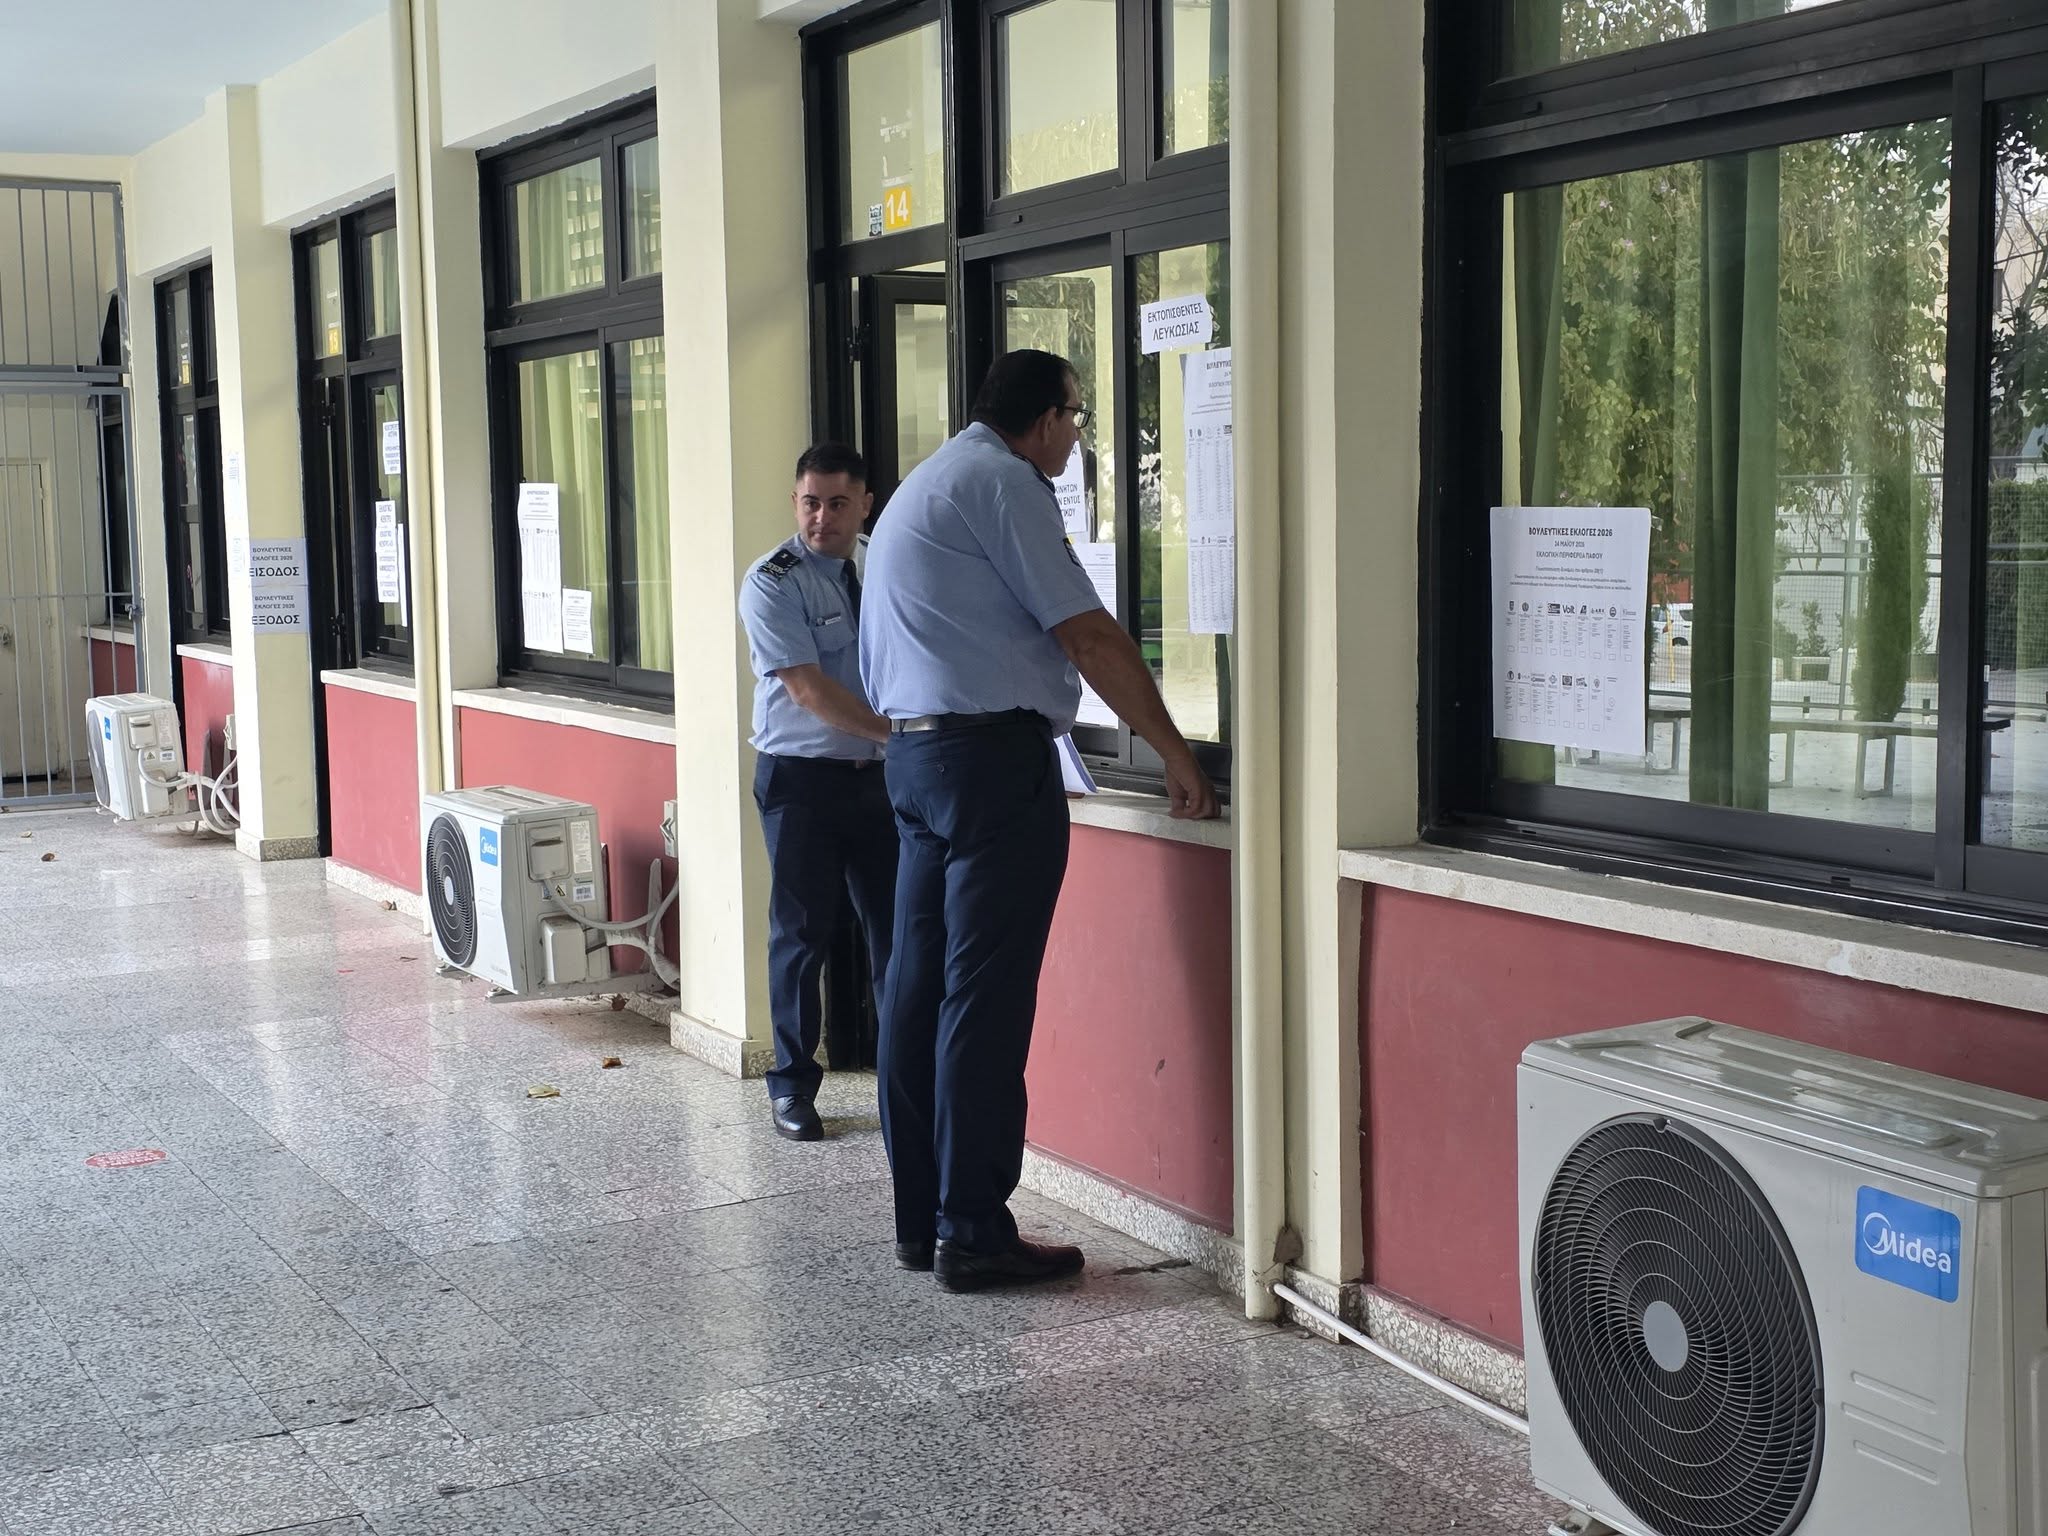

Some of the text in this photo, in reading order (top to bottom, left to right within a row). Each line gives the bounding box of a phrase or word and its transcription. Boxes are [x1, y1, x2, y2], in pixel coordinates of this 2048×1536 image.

[886, 190, 909, 225] 14
[1147, 302, 1203, 323] ΕΚΤΟΠΙΣΘΕΝΤΕΣ
[1152, 321, 1200, 341] ΛΕΥΚΩΣΙΑΣ
[1528, 527, 1613, 537] ΒΟΥΛΕΥΤΙΚΕΣ ΕΚΛΟΓΕΣ 2026
[249, 567, 300, 577] ΕΙΣΟΔΟΣ
[1562, 604, 1575, 614] Volt
[251, 615, 301, 625] ΕΞΟΔΟΣ
[1868, 1220, 1952, 1274] Midea
